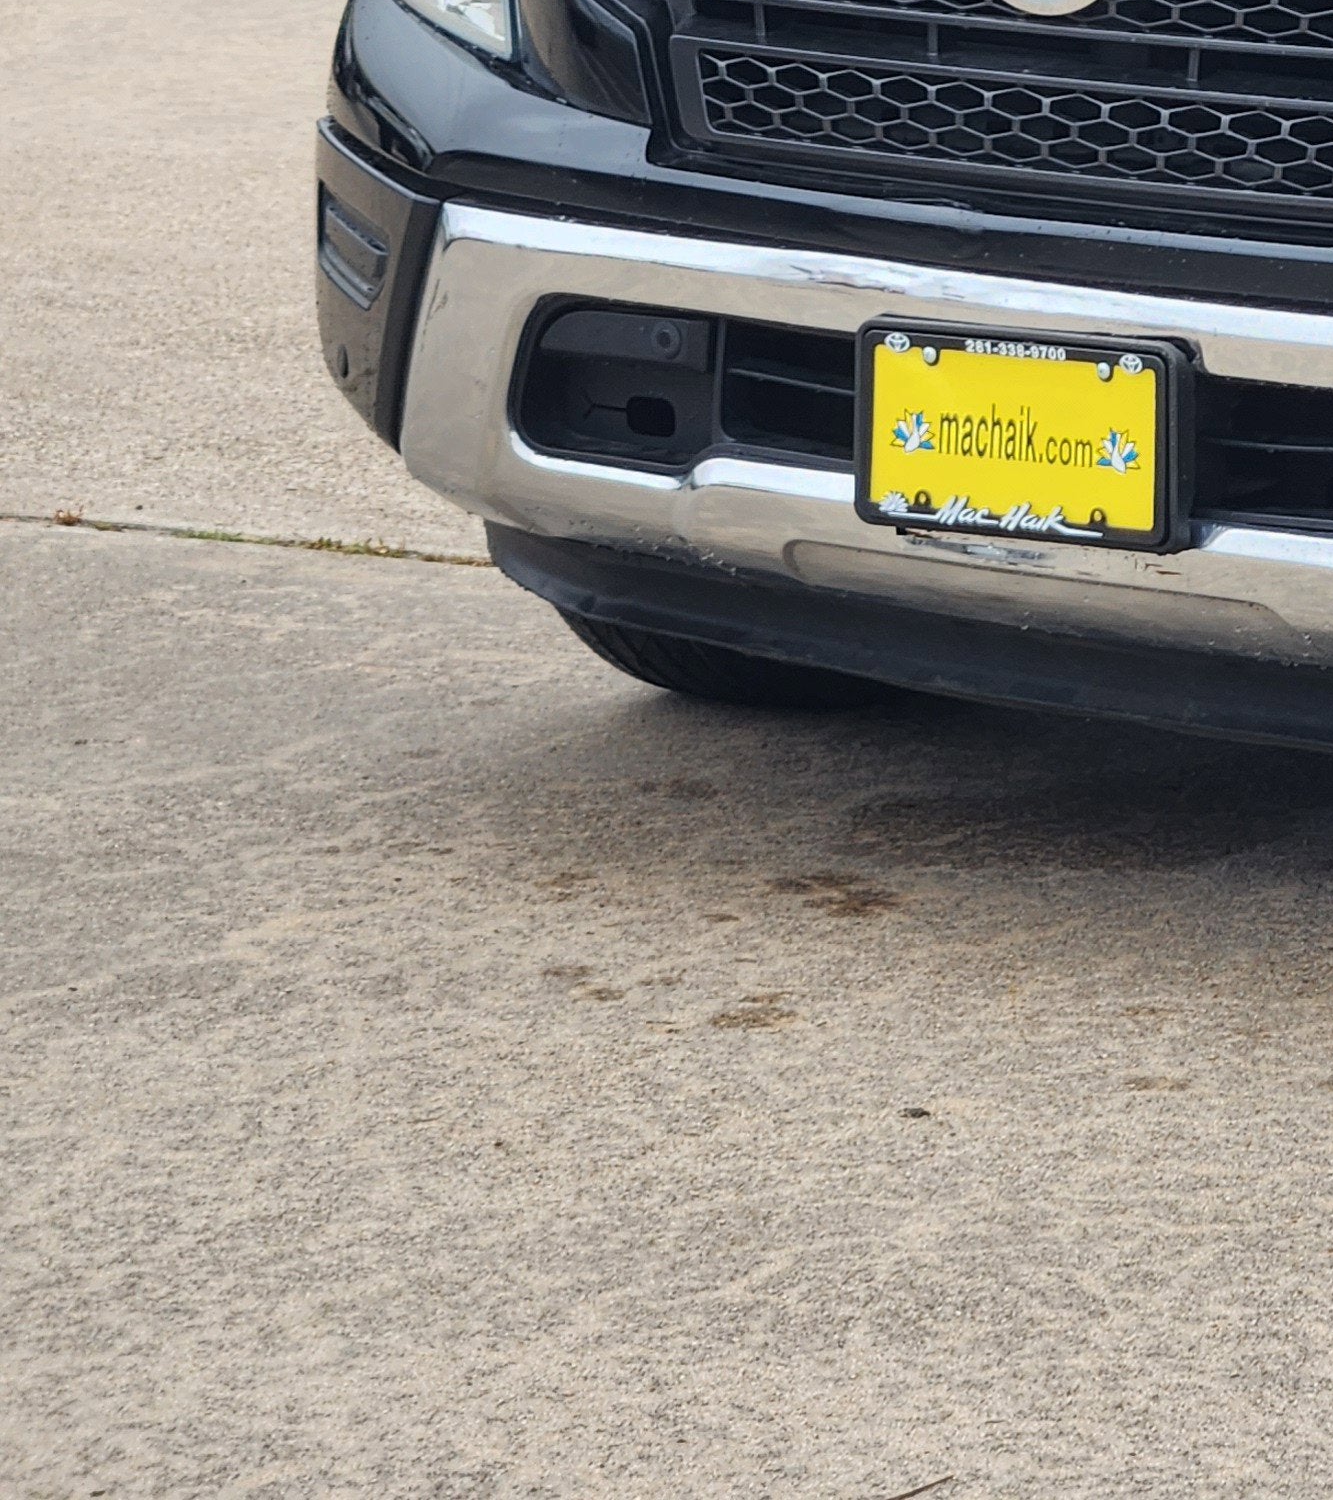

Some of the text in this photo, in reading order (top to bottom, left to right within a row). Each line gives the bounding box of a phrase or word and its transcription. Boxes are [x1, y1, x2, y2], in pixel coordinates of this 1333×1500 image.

[965, 339, 1067, 361] 281-338-9700
[938, 403, 1094, 468] machaik.com
[936, 495, 1076, 532] Mac Haik
